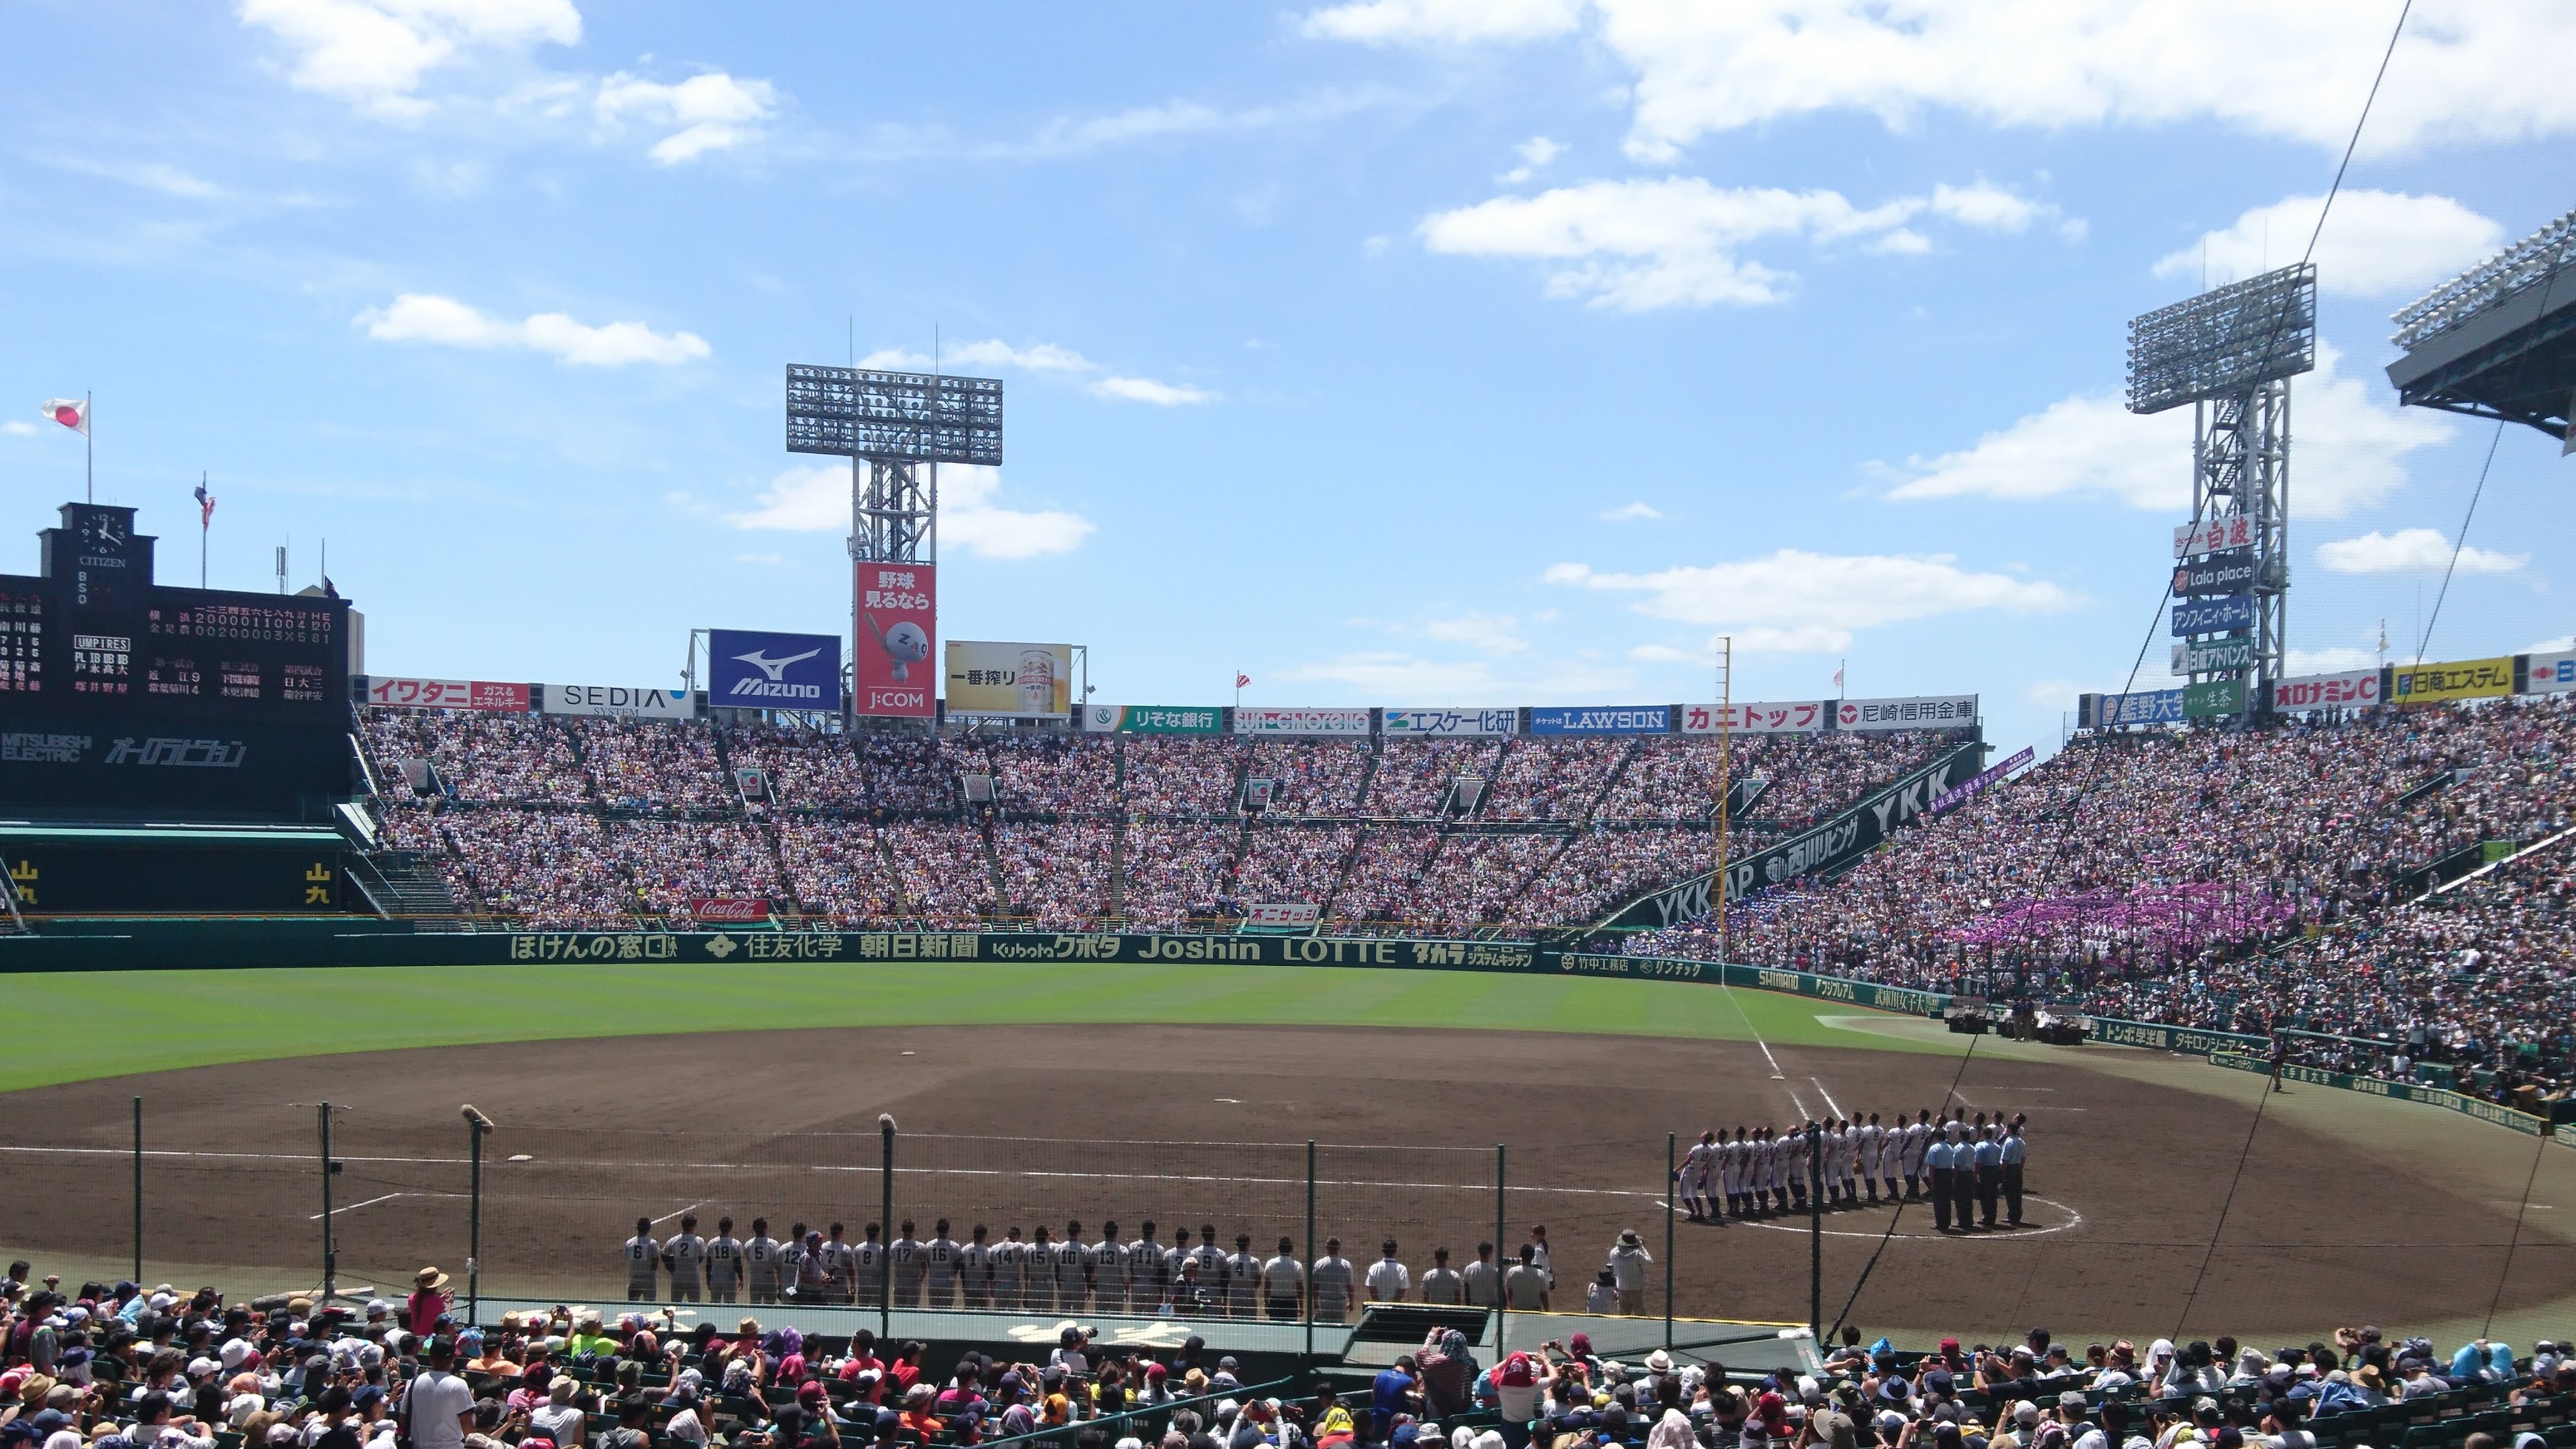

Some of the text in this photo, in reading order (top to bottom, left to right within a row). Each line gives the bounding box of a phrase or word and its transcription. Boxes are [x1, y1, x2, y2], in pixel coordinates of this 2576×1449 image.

[79, 556, 126, 568] CITIZEN
[79, 572, 87, 581] B
[878, 571, 915, 590] 野球
[2190, 565, 2252, 586] Lala place
[79, 583, 87, 593] S
[865, 590, 930, 610] 見るなら
[78, 638, 127, 649] UMPIRES
[951, 669, 1016, 686] 一番搾り
[2557, 659, 2576, 682] 日
[285, 677, 323, 689] 日大三
[2413, 666, 2509, 693] 日商エステム
[372, 679, 468, 703] イワタニ
[565, 685, 666, 708] SEDIA
[2207, 687, 2231, 708] 生茶
[2276, 675, 2378, 707] オロナミンC
[474, 696, 526, 708] エネルギー
[869, 692, 924, 709] J:COM
[594, 707, 639, 717] SYSTEM
[1687, 704, 1819, 730] カニトップ
[1862, 701, 1974, 722] 尼崎信用金庫
[1136, 711, 1213, 728] りそな銀行
[1410, 710, 1516, 732] エスケー化研
[1563, 711, 1665, 729] LAWSON
[1, 733, 92, 749] MITSUBISHI
[2, 748, 80, 763] ELECTRIC
[1872, 764, 1951, 833] YKK
[1788, 814, 1858, 877] 西川リビング
[306, 862, 330, 904] 山九
[1655, 877, 1714, 927] YKK
[511, 935, 1465, 965] ほけんの窓口 住友化学 朝日新聞 Kubota クボタ Joshin LOTTE タカラ
[1468, 953, 1532, 967] システムキッチン
[1578, 957, 1629, 972] 竹中工務店
[1656, 960, 1702, 977] リンテック
[1758, 970, 1799, 991] SHIMANO
[634, 1246, 642, 1259] 6
[680, 1242, 689, 1256] 2
[714, 1246, 730, 1259] 18
[755, 1246, 763, 1259] 5
[784, 1250, 801, 1263] 12
[826, 1250, 835, 1263] 7
[896, 1248, 911, 1262] 17
[931, 1248, 947, 1262] 16
[863, 1250, 872, 1264] 8
[997, 1251, 1013, 1263] 14
[1031, 1251, 1045, 1264] 15
[1061, 1251, 1077, 1265] 10
[1099, 1252, 1115, 1265] 13
[1136, 1250, 1152, 1264] 11
[1203, 1255, 1212, 1269] 9
[1236, 1262, 1245, 1277] 4
